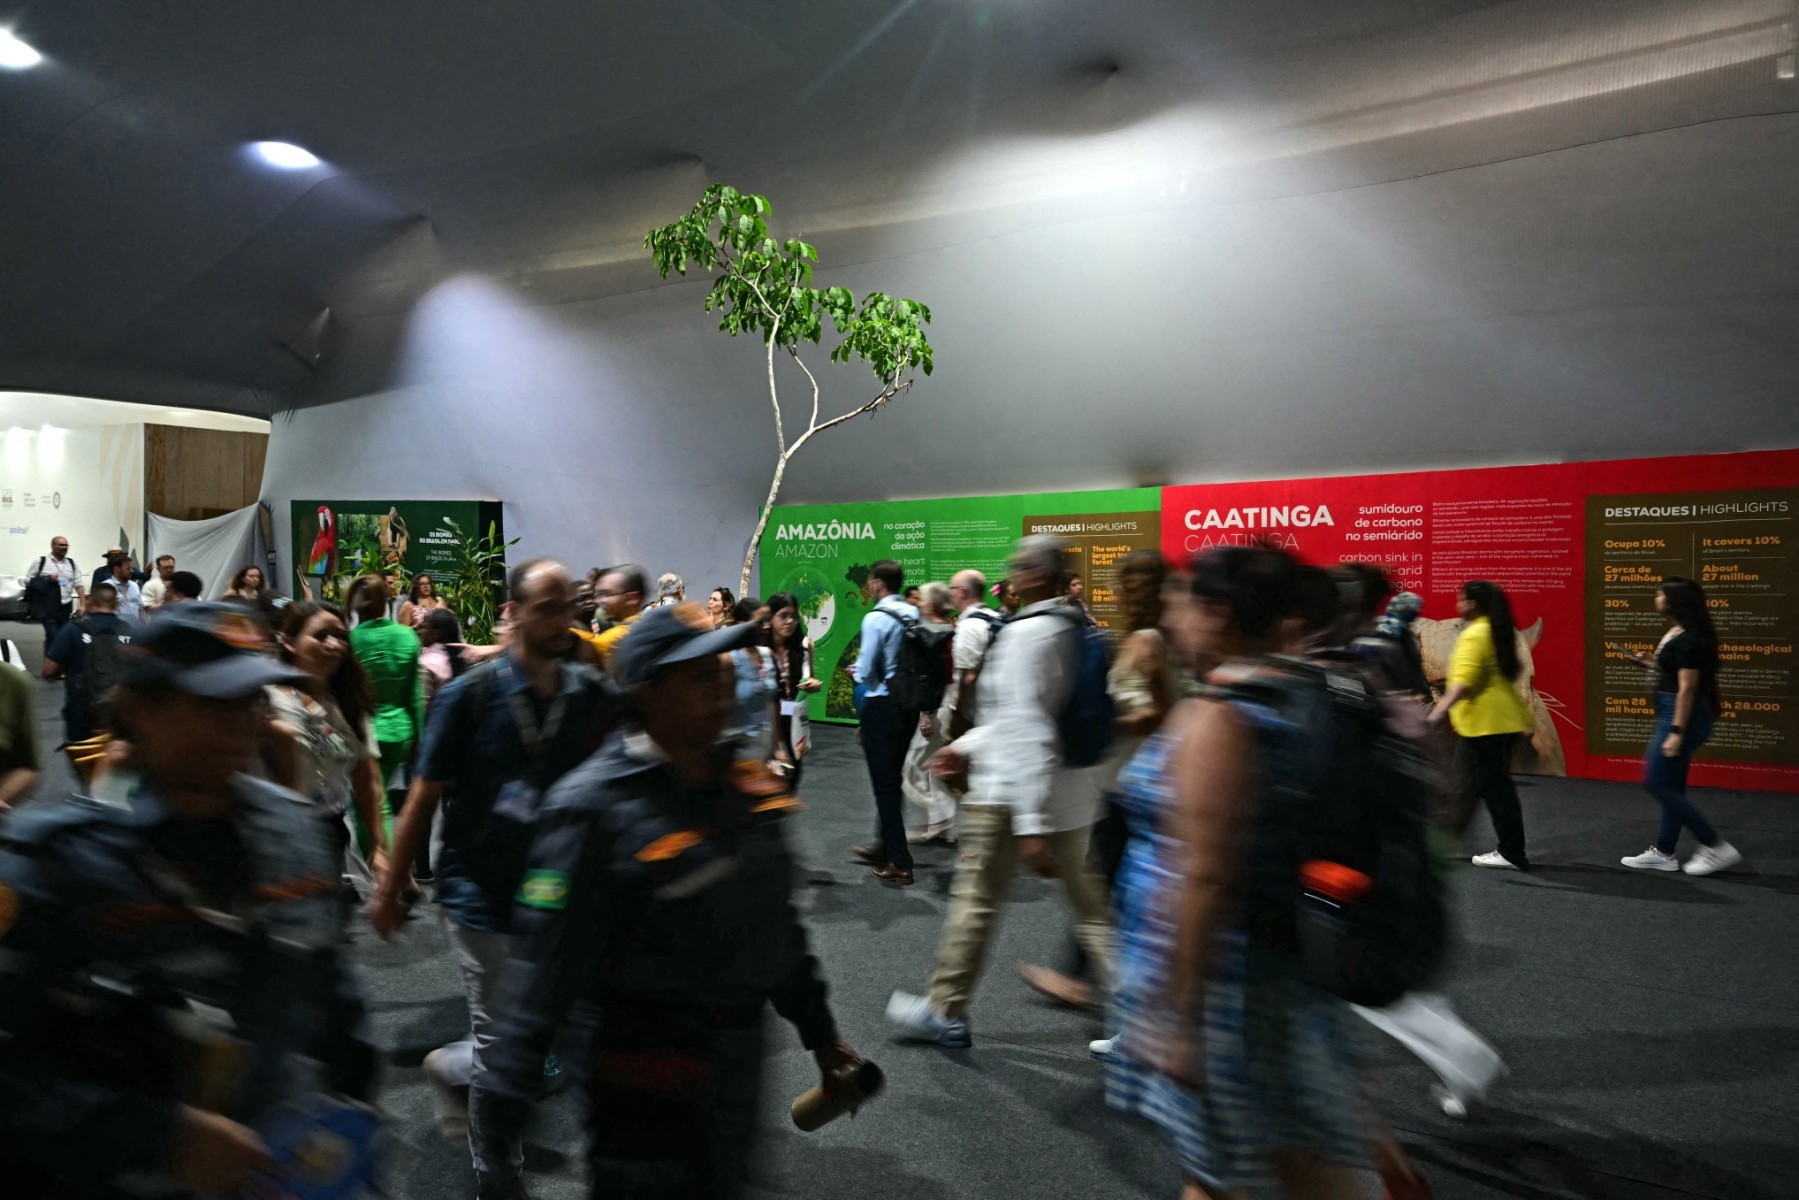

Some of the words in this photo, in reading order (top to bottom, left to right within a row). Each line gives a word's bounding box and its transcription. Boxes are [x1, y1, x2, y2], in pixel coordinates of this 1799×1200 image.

[1359, 504, 1423, 514] sumidouro
[1605, 506, 1689, 518] DESTAQUES
[1700, 502, 1789, 515] HIGHLIGHTS
[1184, 504, 1334, 530] CAATINGA
[894, 521, 925, 531] coração
[1031, 524, 1081, 532] DESTAQUES
[1086, 522, 1138, 531] HIGHLIGHTS
[1354, 518, 1370, 528] de
[1372, 517, 1423, 527] carbono
[775, 519, 876, 540] AMAZÔNIA
[906, 532, 925, 541] ação
[1346, 533, 1360, 541] no
[1363, 530, 1423, 540] semiárido
[891, 542, 925, 550] climática
[1184, 532, 1300, 552] CAATINGA
[1604, 540, 1640, 549] Ocupa
[1642, 539, 1666, 548] 10%
[1702, 538, 1712, 546] It
[1755, 536, 1780, 544] 10%
[774, 544, 838, 558] AMAZON
[1340, 552, 1382, 562] carbon
[1385, 552, 1408, 562] sink
[1412, 552, 1422, 562] in
[905, 568, 926, 576] mate
[1382, 565, 1422, 576] mi-arid
[1604, 566, 1636, 574] Cerca
[1638, 566, 1652, 574] de
[1702, 564, 1739, 573] About
[1604, 574, 1618, 582] 27
[1620, 574, 1663, 582] milhões
[1702, 573, 1718, 581] 27
[1720, 572, 1759, 580] million
[1388, 578, 1422, 592] egion
[1604, 600, 1630, 608] 30%
[1718, 643, 1792, 656] chaeological
[1605, 696, 1628, 705] Com
[1632, 698, 1646, 706] 28
[1624, 706, 1655, 714] horas
[1734, 702, 1780, 711] 28.000
